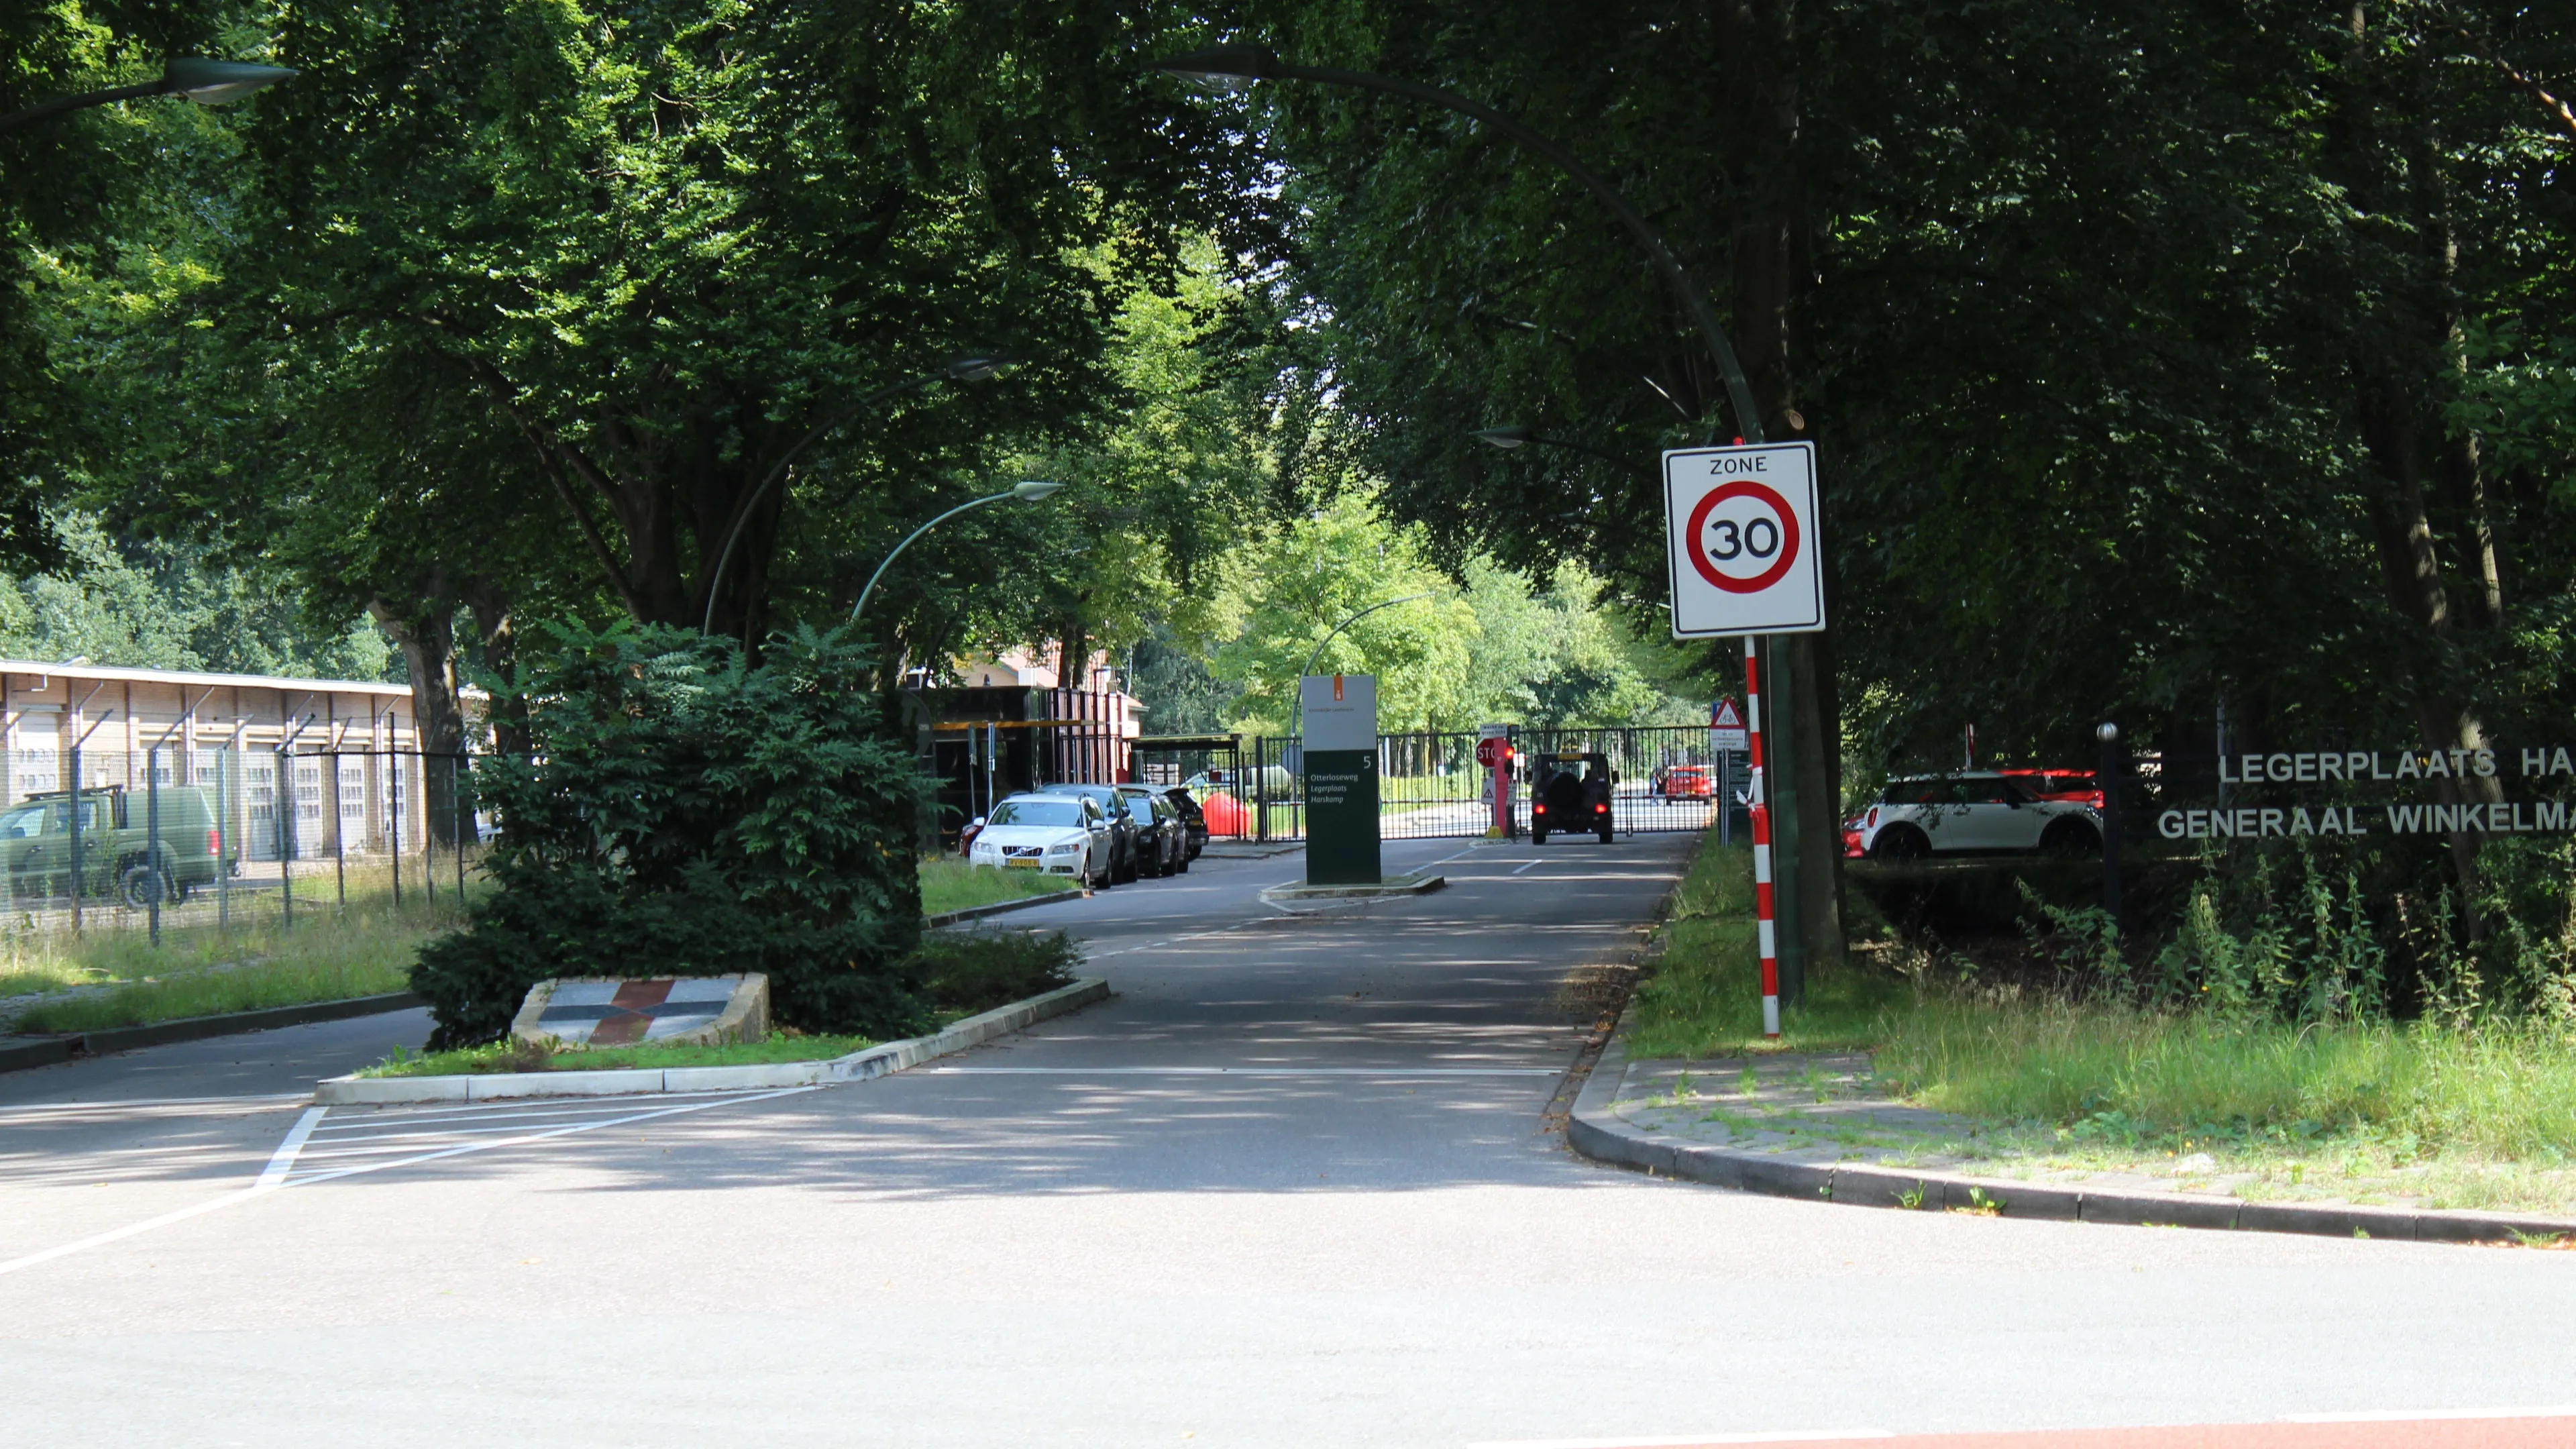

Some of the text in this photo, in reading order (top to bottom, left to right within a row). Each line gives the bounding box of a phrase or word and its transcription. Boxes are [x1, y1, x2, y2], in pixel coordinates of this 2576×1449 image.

[1710, 456, 1768, 475] ZONE
[1710, 517, 1778, 561] 30
[1477, 747, 1495, 759] STO
[1363, 755, 1371, 769] 5
[2220, 747, 2575, 783] LEGERPLAATS HA
[1310, 773, 1358, 782] Otterloseweg
[1311, 785, 1347, 793] Legerplaats
[1311, 796, 1344, 804] Harskamp
[2158, 806, 2367, 839] GENERAAL
